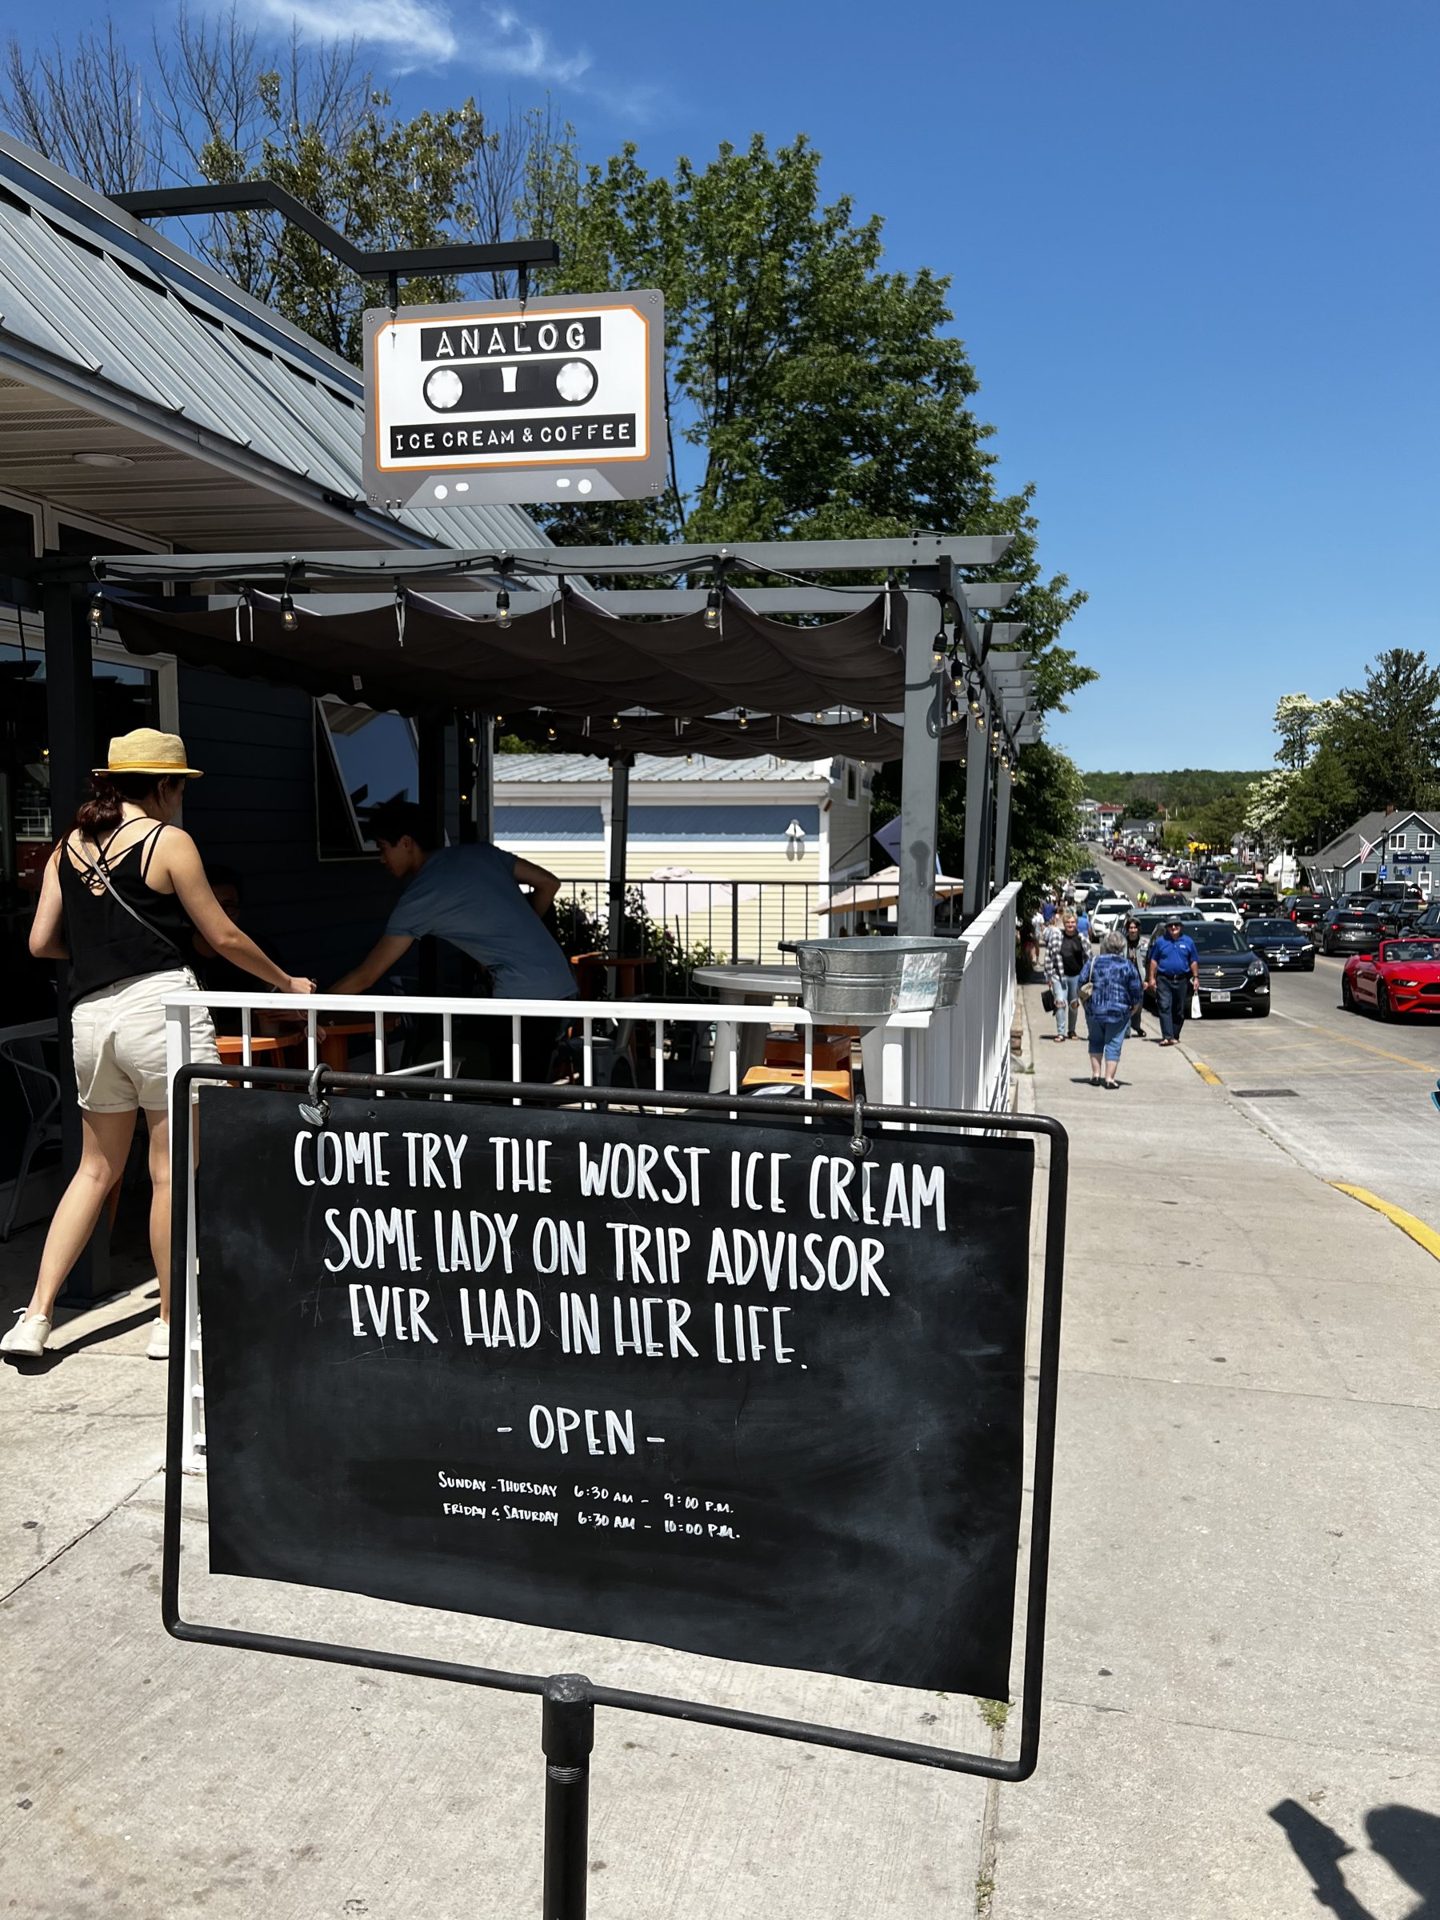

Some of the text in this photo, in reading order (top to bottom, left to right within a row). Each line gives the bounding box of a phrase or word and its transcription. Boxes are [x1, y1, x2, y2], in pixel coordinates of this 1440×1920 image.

[435, 322, 586, 358] ANALOG
[396, 423, 631, 451] ICE CREAM & COFFEE
[295, 1131, 947, 1232] COME TRY THE WORST ICE CREAM
[324, 1207, 891, 1297] SOME LADY ON TRIP ADVISOR
[349, 1284, 808, 1370] EVER HAD IN HER LIFE.
[528, 1404, 636, 1456] OPEN
[437, 1471, 487, 1492] SUNDAY
[573, 1484, 609, 1500] 6:30
[664, 1492, 699, 1510] 9:00
[503, 1505, 559, 1527] SATURDAY
[578, 1511, 610, 1528] 6:30
[613, 1515, 636, 1530] AM
[664, 1519, 703, 1536] 10:00
